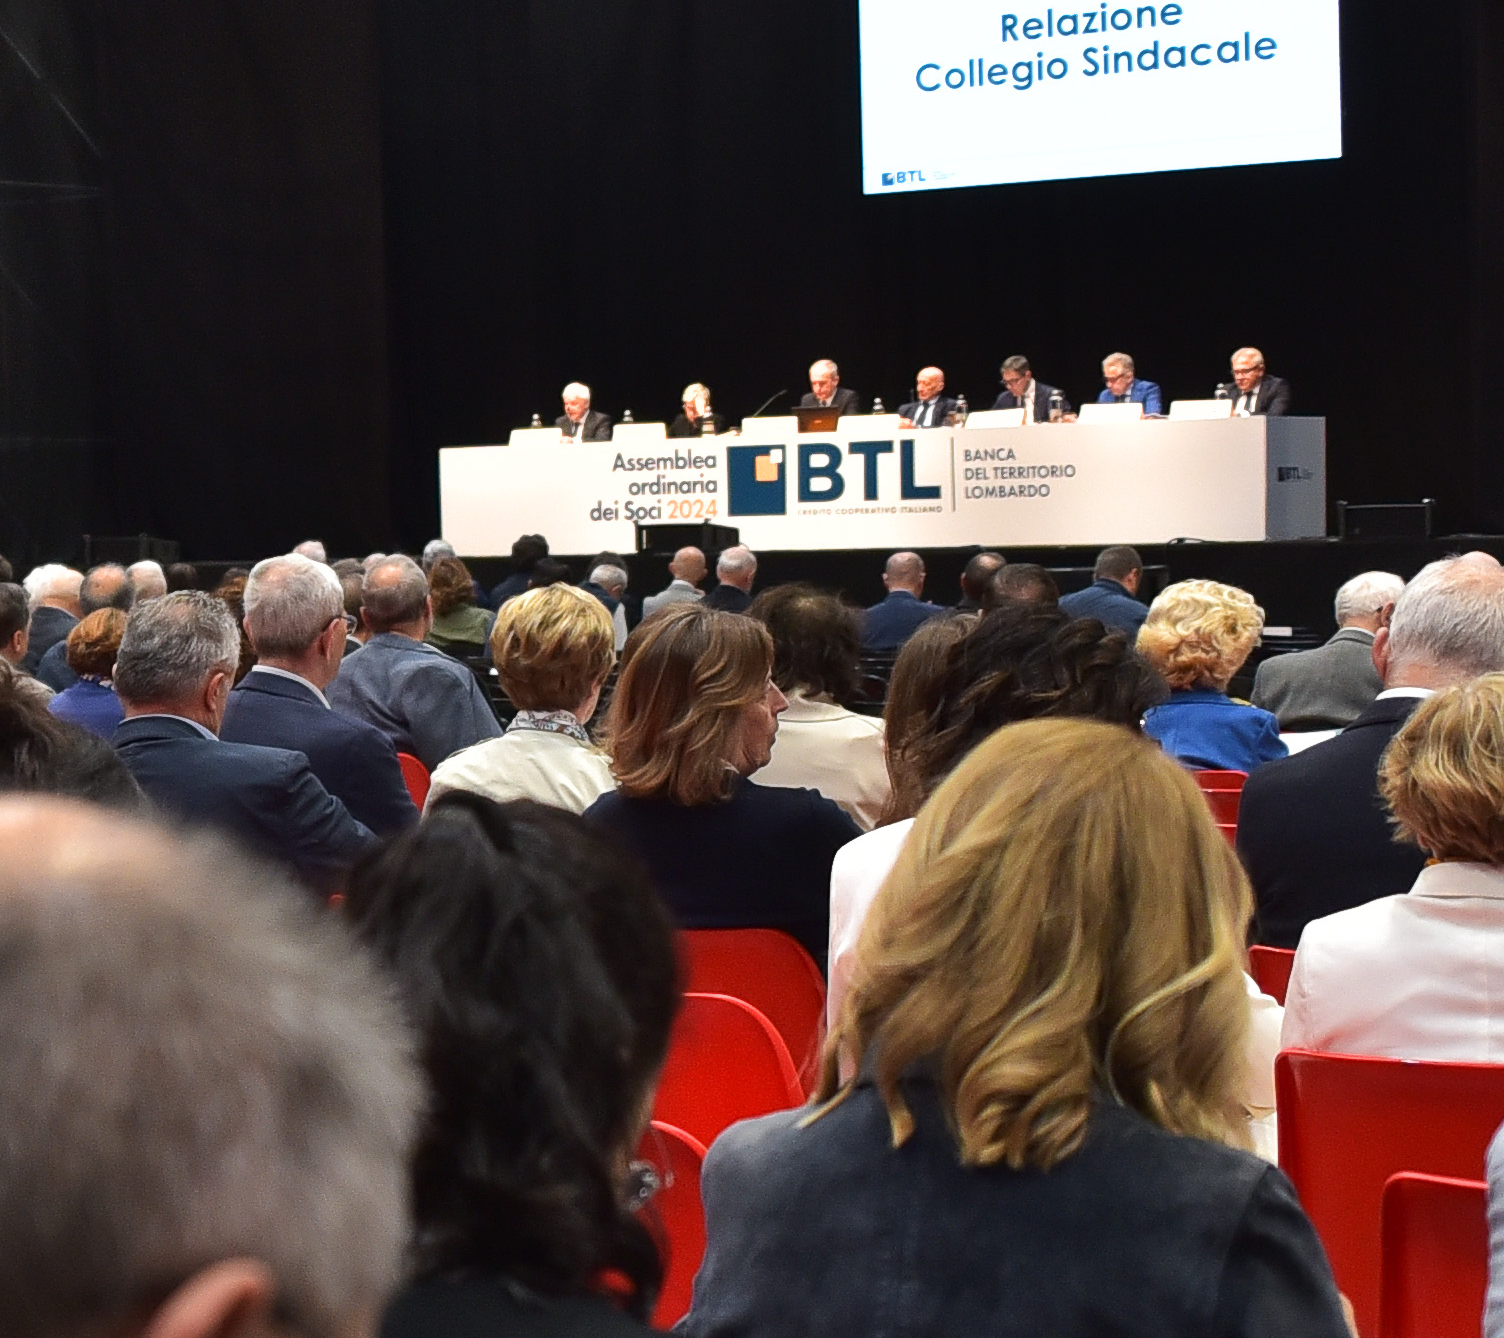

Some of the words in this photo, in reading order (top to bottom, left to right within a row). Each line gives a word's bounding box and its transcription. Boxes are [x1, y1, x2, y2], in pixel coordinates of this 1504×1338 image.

[1001, 2, 1183, 43] Relazione
[916, 51, 1069, 92] Collegio
[1083, 32, 1278, 77] Sindacale
[896, 170, 927, 184] BTL
[612, 451, 717, 473] Assemblea
[964, 448, 1016, 462] BANCA
[797, 439, 942, 503] BTL
[965, 467, 991, 481] DEL
[993, 464, 1076, 480] TERRITORIO
[628, 474, 717, 496] ordinaria
[965, 484, 1051, 499] LOMBARDO
[590, 501, 619, 521] dei
[624, 500, 662, 521] Soci
[667, 499, 718, 519] 2024
